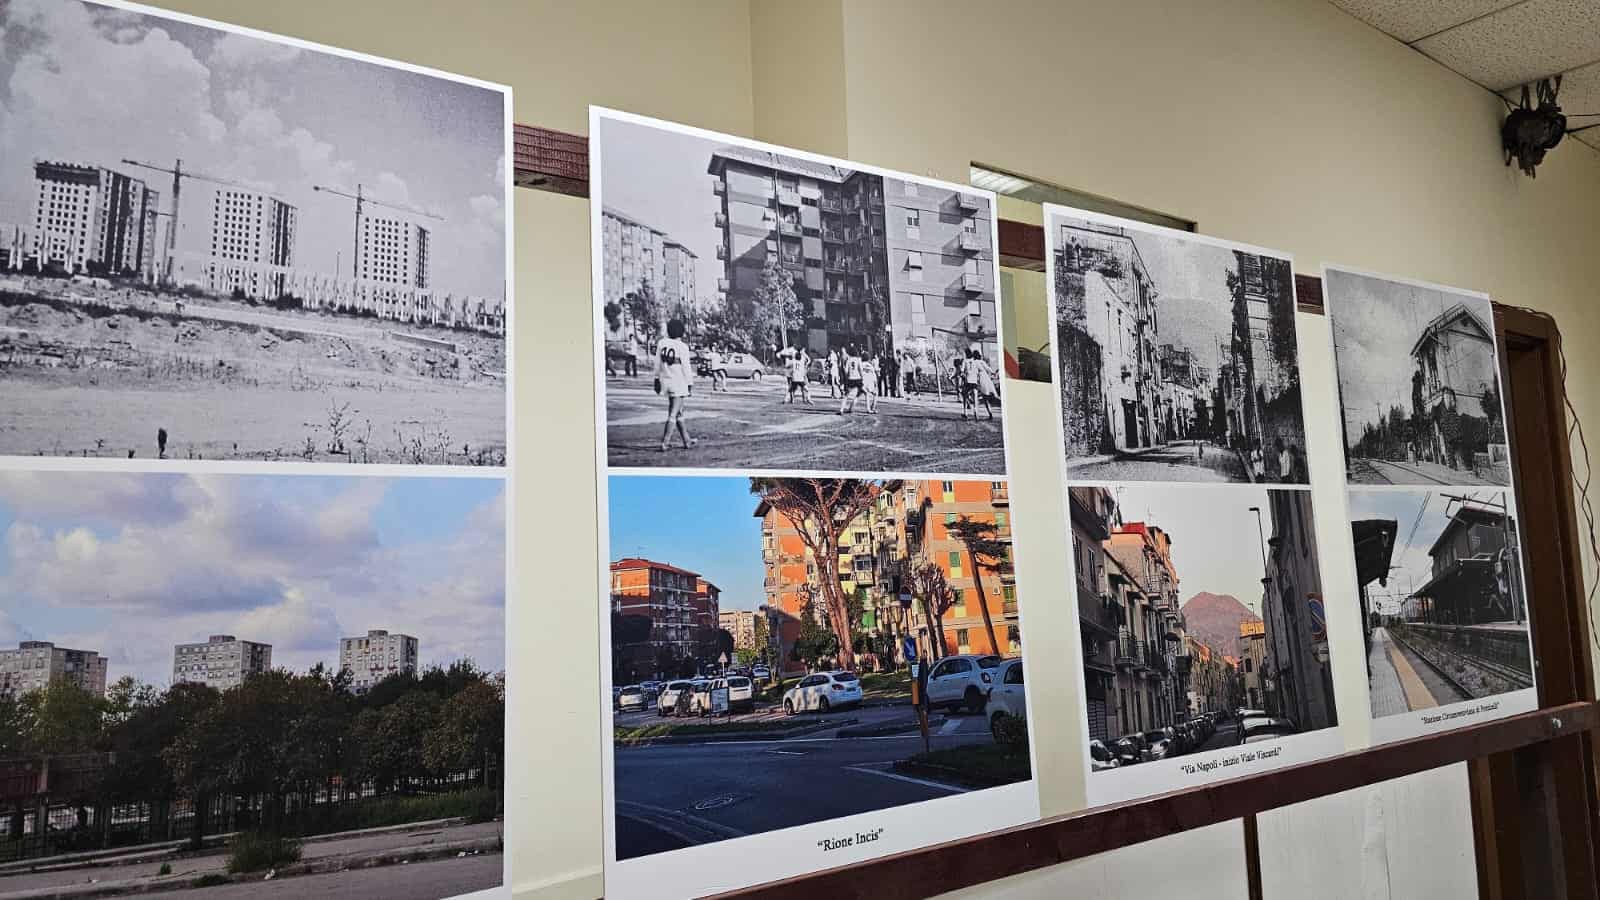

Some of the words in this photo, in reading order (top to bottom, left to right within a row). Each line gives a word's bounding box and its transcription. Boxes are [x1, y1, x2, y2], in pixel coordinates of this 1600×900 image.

[661, 347, 675, 366] 10
[1197, 760, 1217, 772] Napoli
[817, 837, 853, 851] “Rione
[855, 828, 884, 845] Incis”
